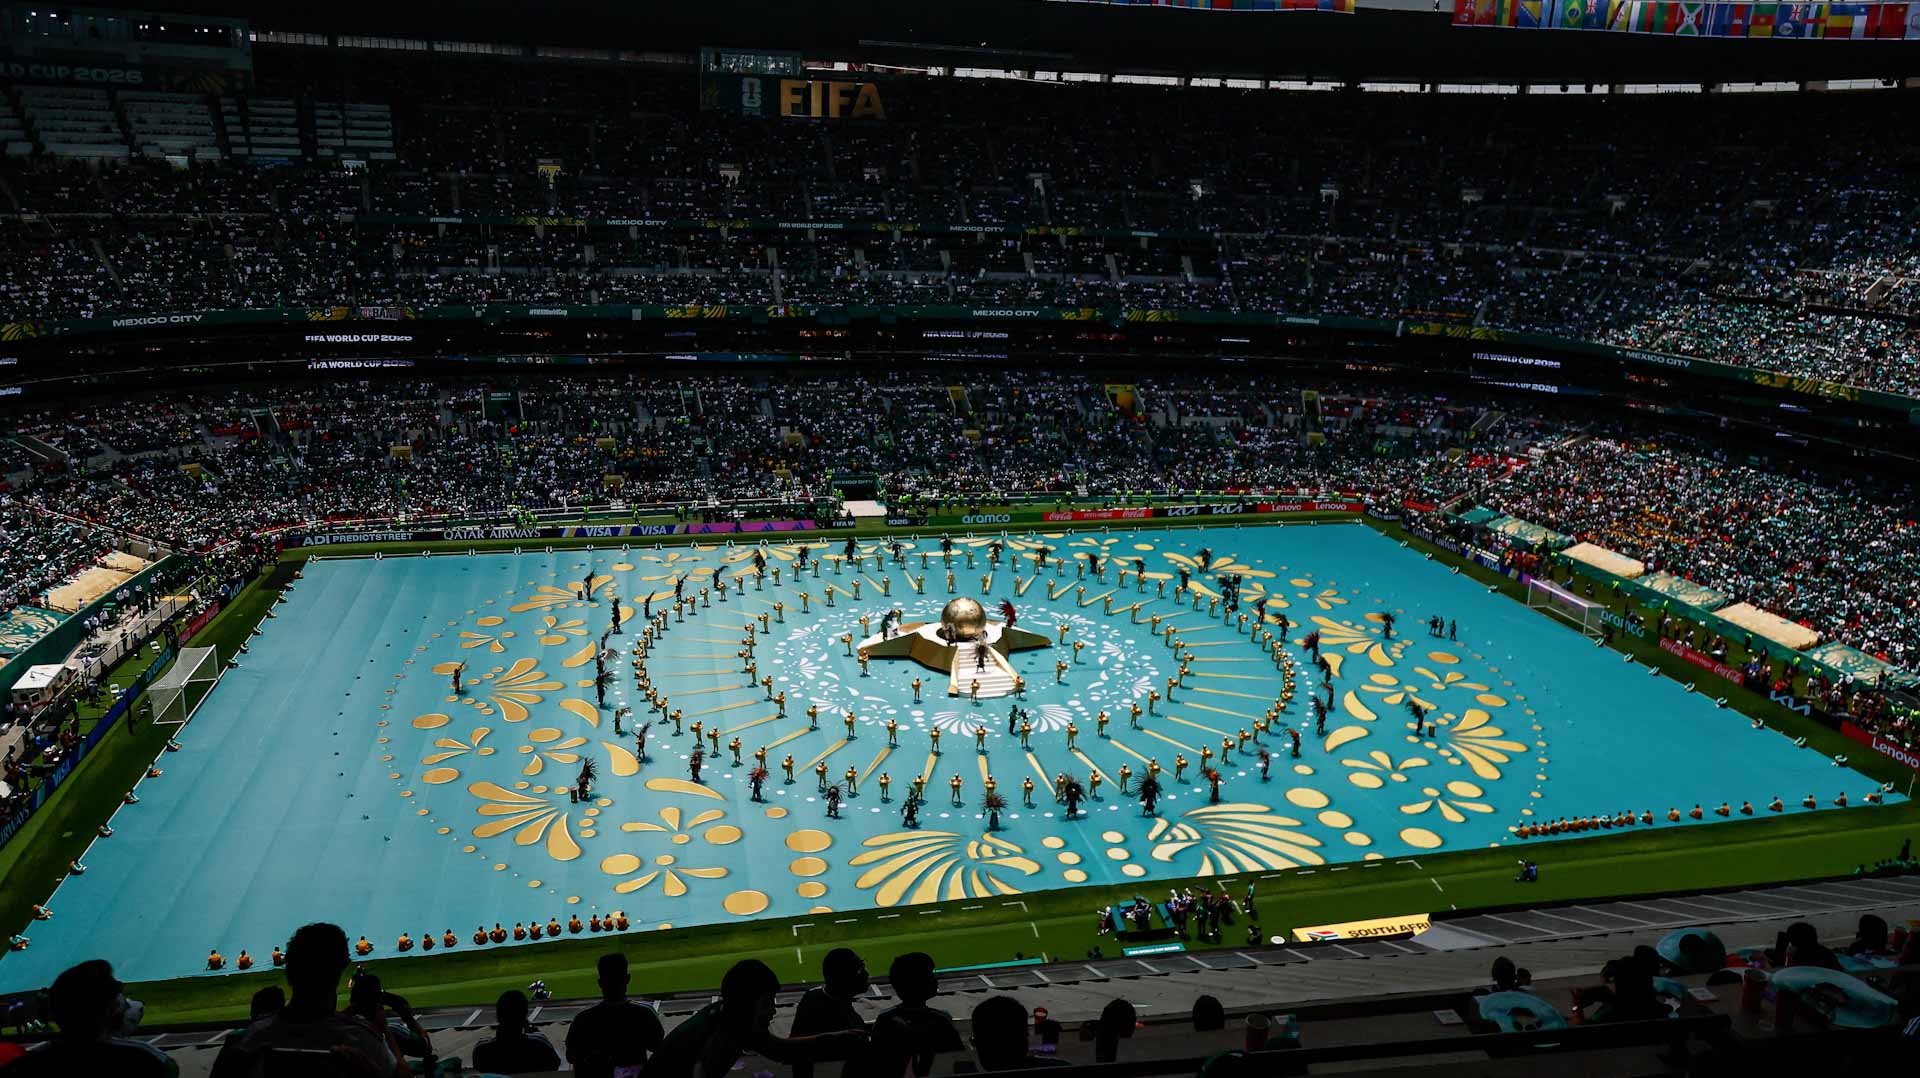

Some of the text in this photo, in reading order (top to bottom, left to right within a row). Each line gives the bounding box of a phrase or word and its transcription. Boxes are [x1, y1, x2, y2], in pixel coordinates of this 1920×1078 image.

[30, 65, 71, 78] CUP
[73, 66, 144, 83] 2026
[780, 79, 884, 119] FIFA
[113, 315, 201, 327] MEXICO CITY
[1490, 354, 1518, 364] WORLD
[1518, 357, 1534, 365] CUP
[1625, 350, 1691, 367] MEXICO CITY
[1532, 384, 1558, 393] 2026
[1168, 506, 1198, 516] KIA
[1212, 504, 1243, 514] KIA
[1272, 503, 1301, 512] Lenovo
[1315, 502, 1347, 511] Lenovo
[962, 513, 1010, 524] aramco
[444, 528, 541, 540] QATAR AIRWAYS
[585, 527, 612, 537] VISA
[640, 525, 666, 535] VISA
[303, 532, 413, 546] ADI PREDICTSTREET
[1483, 557, 1500, 572] VISA
[1601, 610, 1645, 638] aramco
[1770, 690, 1811, 716] KIA
[1872, 737, 1920, 769] Lenovo
[53, 758, 71, 787] VISA
[1348, 925, 1397, 938] SOUTH
